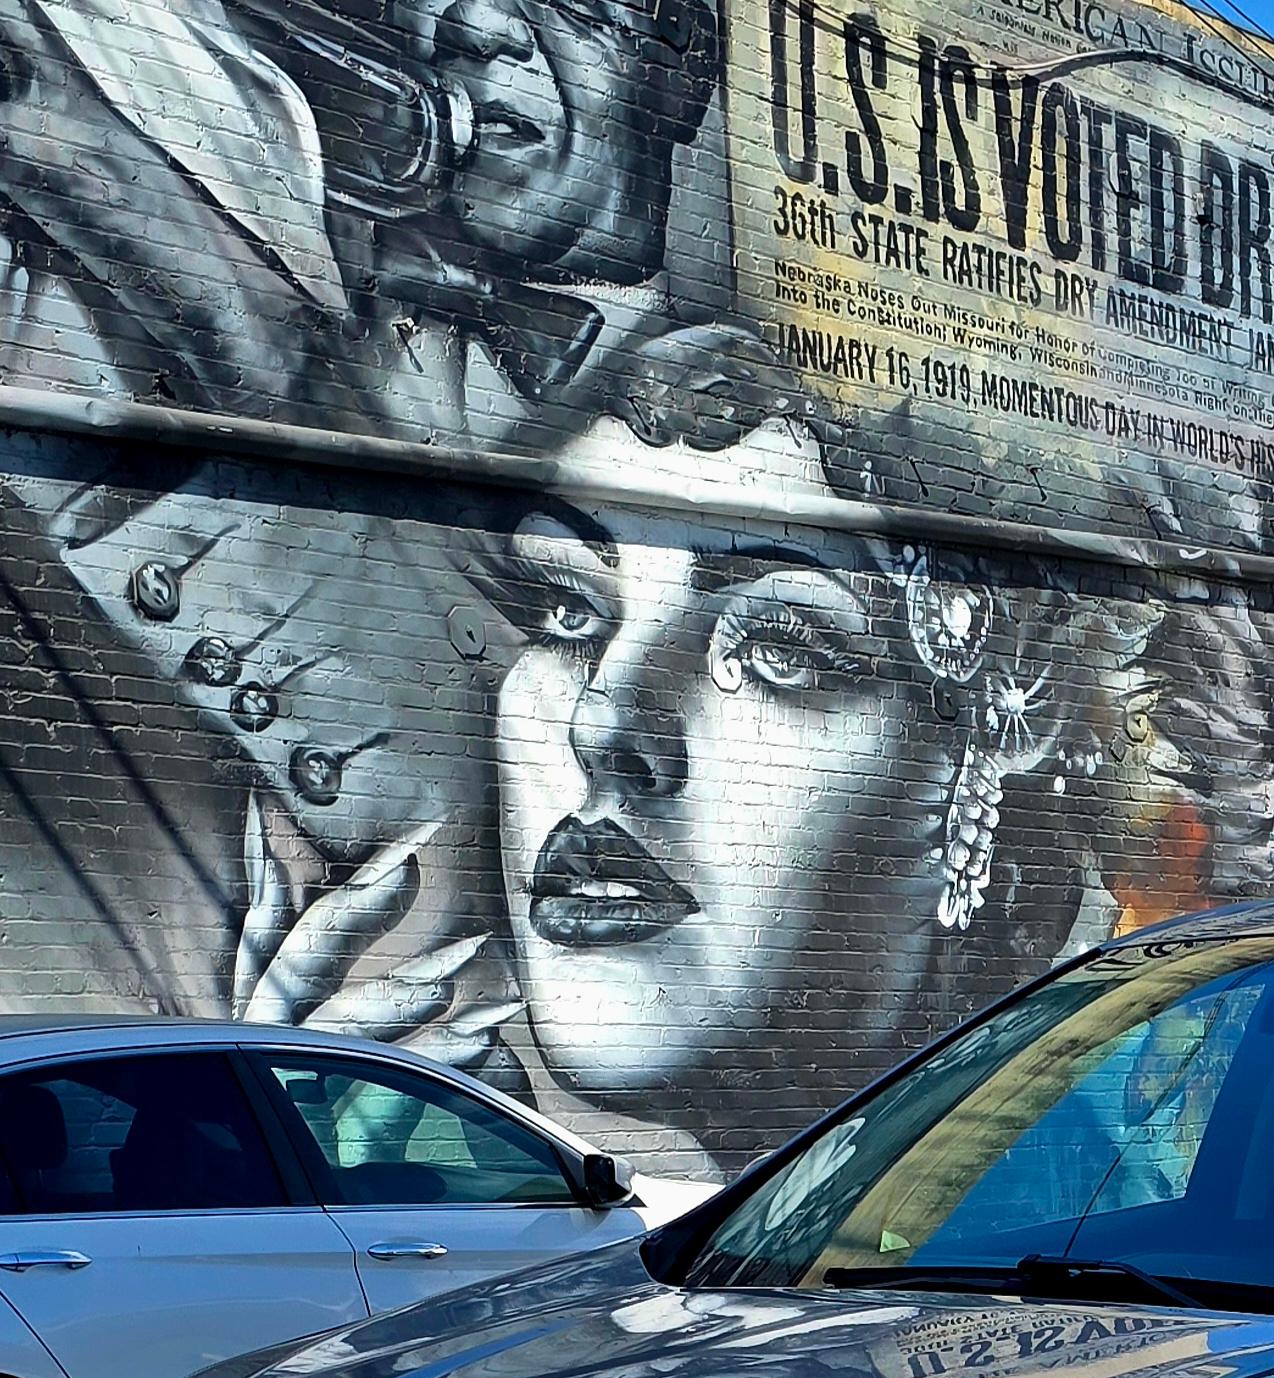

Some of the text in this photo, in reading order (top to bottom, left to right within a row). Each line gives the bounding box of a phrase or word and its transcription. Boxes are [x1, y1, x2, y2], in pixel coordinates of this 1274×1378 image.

[991, 61, 1189, 295] VOTED
[773, 185, 836, 249] 36th
[850, 211, 930, 277] STATE
[942, 234, 1043, 309] RATIFIES
[1054, 267, 1099, 321] DRY
[1104, 285, 1234, 358] AMENDMENT
[774, 259, 850, 293] Nebraska
[857, 283, 905, 310] Noses
[911, 295, 939, 316] Out
[943, 304, 1006, 334] Missouri
[1009, 318, 1030, 340] for
[1034, 325, 1079, 353] Honor
[1081, 337, 1097, 355] of
[1222, 381, 1265, 410] Writing
[775, 283, 808, 304] Into
[813, 289, 841, 312] the
[952, 326, 1023, 361] Wyoming,
[1029, 347, 1098, 378] Wisconsin
[1194, 390, 1228, 411] Right
[1233, 404, 1248, 418] on
[777, 322, 877, 384] JANUARY
[885, 345, 918, 396] 16,
[920, 354, 979, 408] 1919,
[981, 369, 1101, 432] MOMENTOUS
[1104, 399, 1141, 442] DAY
[1147, 411, 1166, 451] IN
[1168, 416, 1246, 470] WORLD'S
